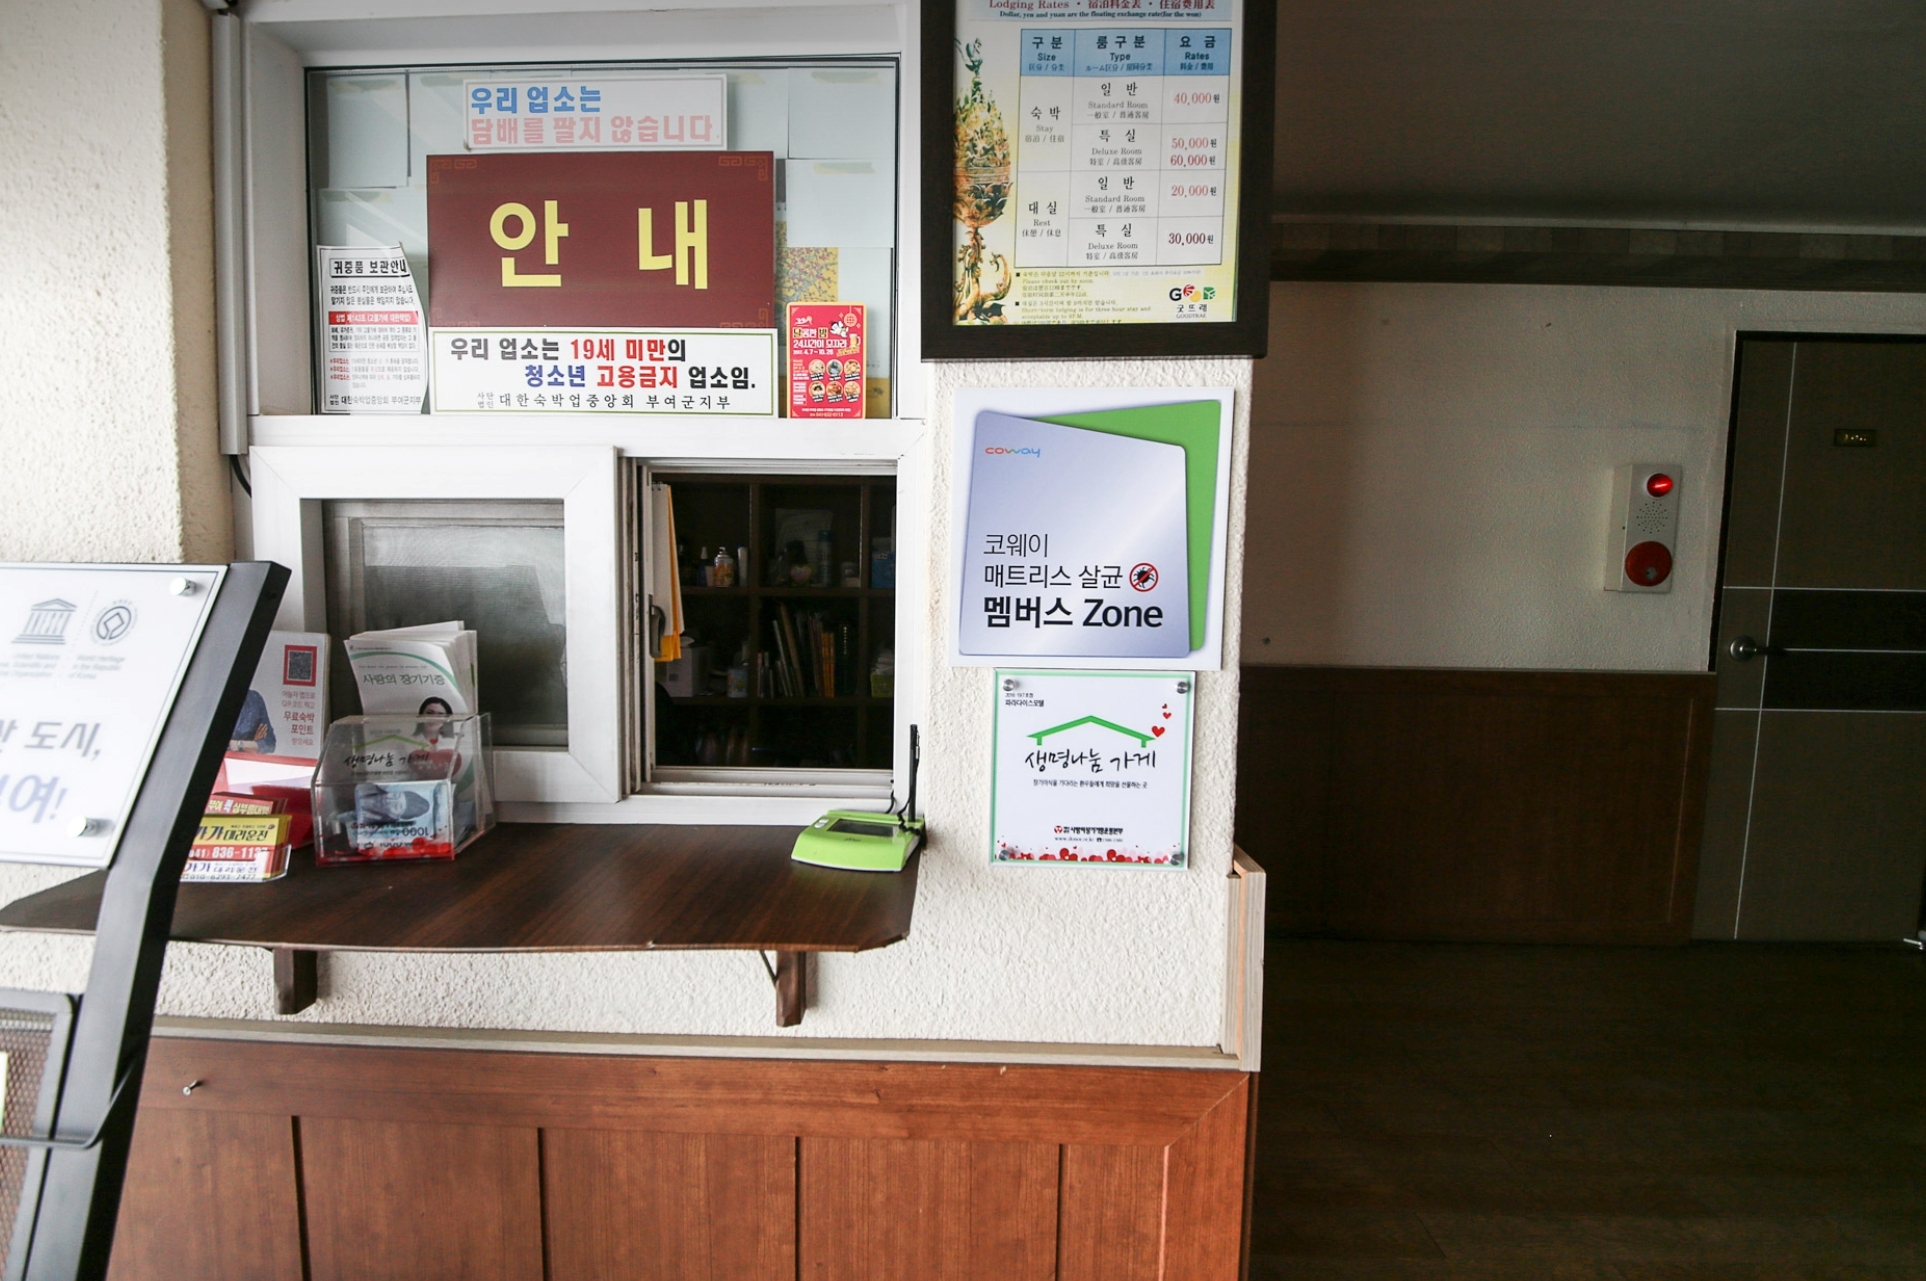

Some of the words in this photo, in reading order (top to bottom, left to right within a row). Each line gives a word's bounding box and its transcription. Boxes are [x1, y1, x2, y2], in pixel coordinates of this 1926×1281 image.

[989, 0, 1034, 10] Lodging
[1038, 0, 1069, 9] Rates
[1037, 53, 1056, 61] Size
[1110, 53, 1131, 62] Type
[1185, 52, 1210, 60] Rates
[471, 87, 518, 114] 우리
[526, 85, 601, 113] 업소는
[1088, 101, 1124, 109] Standard
[1127, 101, 1148, 109] Room
[471, 117, 544, 145] 담배를
[553, 116, 600, 143] 팔지
[1036, 124, 1054, 133] Stay
[1085, 195, 1121, 203] Standard
[1117, 242, 1138, 250] Room
[334, 261, 364, 274] 귀중품
[451, 338, 489, 360] 우리
[499, 338, 559, 361] 업소는
[570, 339, 615, 361] 19세
[626, 339, 686, 362] 미만의
[525, 365, 585, 387] 청소년
[596, 366, 678, 388] 고용금지
[688, 366, 756, 389] 업소임.
[985, 447, 1041, 458] coway
[983, 534, 1048, 557] 코웨이
[984, 564, 1072, 589] 매트리스
[1078, 565, 1124, 589] 살균
[983, 596, 1074, 628] 멤버스
[1082, 599, 1164, 627] Zone
[363, 673, 397, 686] 사랑의
[400, 674, 445, 686] 장기기증
[283, 711, 315, 723] 무료숙박
[291, 724, 314, 736] 포인트
[23, 721, 101, 761] 도시,
[1025, 748, 1103, 773] 생명나눔
[1110, 750, 1156, 772] 가게
[223, 829, 269, 842] 대리운전
